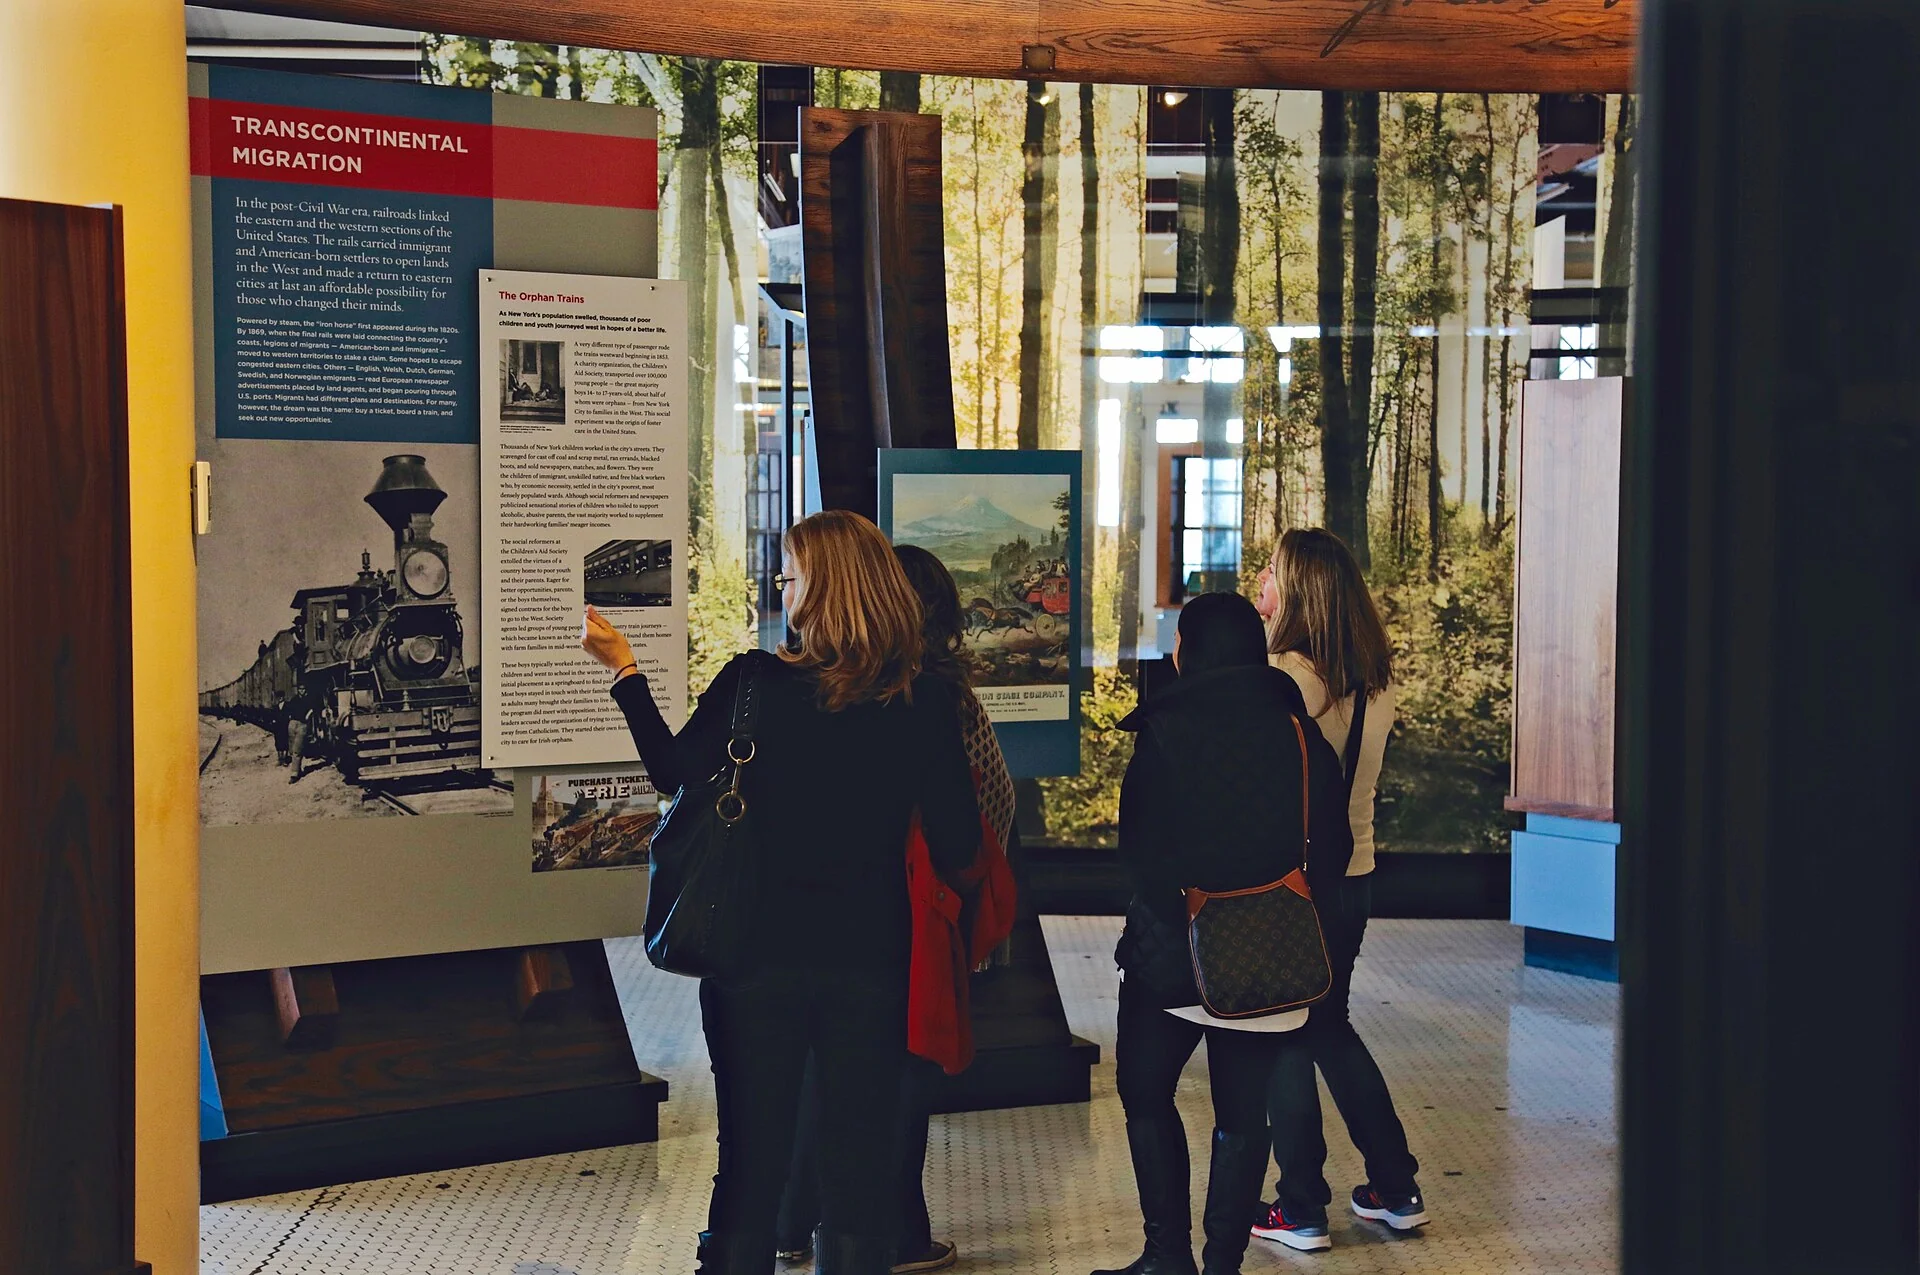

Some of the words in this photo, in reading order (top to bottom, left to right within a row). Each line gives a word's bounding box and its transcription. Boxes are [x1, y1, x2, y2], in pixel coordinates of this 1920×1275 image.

[231, 115, 469, 154] TRANSCONTINENTAL
[232, 146, 362, 174] MIGRATION
[236, 196, 248, 208] In
[250, 197, 268, 210] the
[270, 201, 324, 214] post-Civil
[327, 203, 350, 215] War
[351, 208, 371, 218] era,
[372, 206, 417, 220] railroads
[418, 209, 450, 222] linked
[235, 212, 253, 225] the
[255, 217, 294, 227] eastern
[296, 218, 316, 229] and
[318, 218, 336, 230] the
[338, 223, 379, 233] western
[380, 224, 422, 236] sections
[423, 226, 436, 237] of
[436, 226, 453, 238] the
[236, 228, 274, 242] United
[276, 231, 310, 244] States.
[312, 233, 336, 246] The
[337, 235, 359, 247] rails
[360, 238, 397, 250] carried
[399, 240, 452, 255] immigrant
[235, 245, 256, 257] and
[258, 246, 341, 262] American-born
[343, 252, 380, 264] settlers
[382, 256, 394, 265] to
[395, 258, 421, 268] open
[423, 256, 450, 269] lands
[236, 261, 248, 272] in
[250, 261, 269, 274] the
[272, 263, 300, 276] West
[302, 265, 323, 277] and
[326, 266, 355, 279] made
[357, 271, 364, 279] a
[366, 271, 399, 281] return
[402, 273, 413, 282] to
[415, 274, 452, 284] eastern
[236, 277, 266, 289] cities
[268, 281, 279, 290] at
[281, 278, 300, 291] last
[302, 284, 316, 292] an
[319, 281, 374, 295] affordable
[376, 285, 429, 301] possibility
[431, 287, 447, 299] for
[498, 291, 518, 301] The
[519, 292, 555, 303] Orphan
[556, 294, 585, 304] Trains
[236, 292, 267, 305] those
[268, 294, 293, 307] who
[294, 295, 339, 311] changed
[342, 298, 368, 310] their
[370, 300, 404, 312] minds.
[236, 316, 268, 325] Powered
[268, 318, 278, 326] by
[279, 319, 302, 327] steam,
[334, 321, 357, 329] horse"
[404, 325, 427, 334] during
[440, 326, 460, 334] 1820s.
[236, 327, 247, 336] By
[248, 328, 267, 336] 1869,
[366, 334, 404, 343] connecting
[554, 322, 585, 331] journeyed
[274, 394, 305, 402] Migrants
[320, 395, 349, 403] different
[652, 446, 666, 454] They
[568, 778, 612, 787] PURCHASE
[584, 784, 630, 800] ERIE
